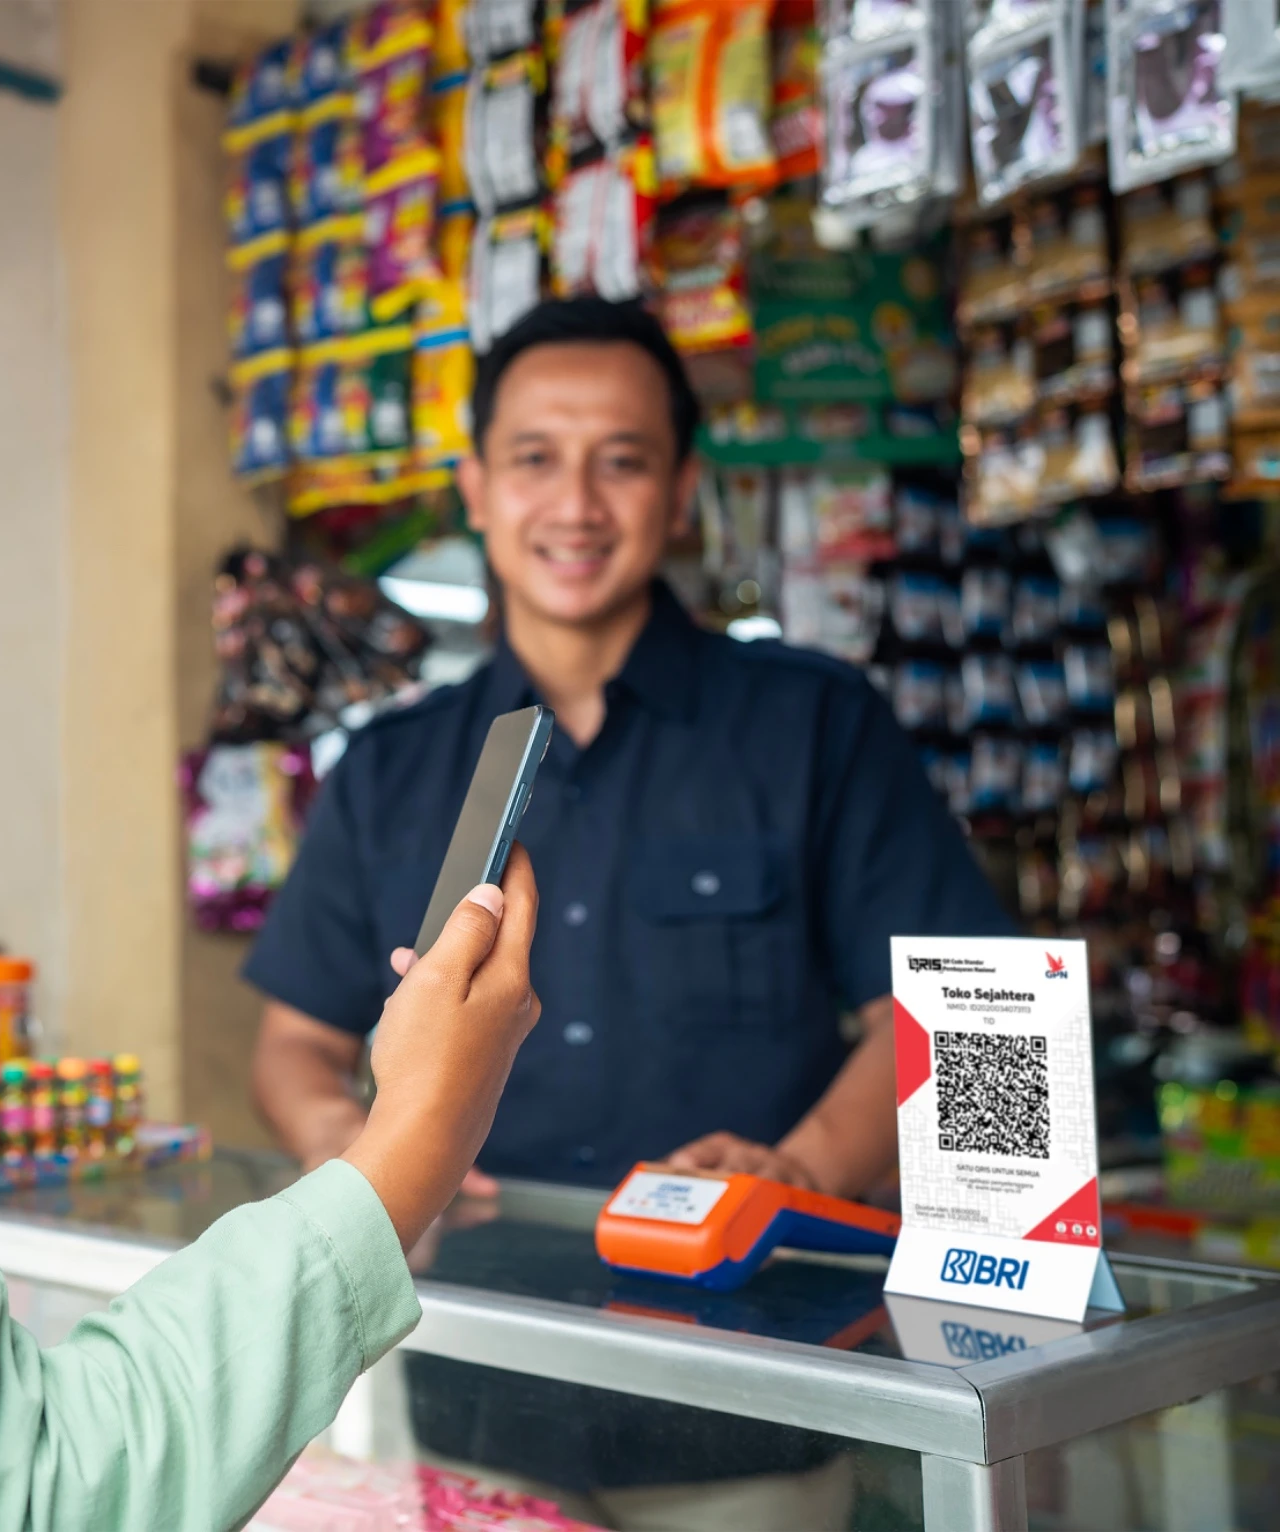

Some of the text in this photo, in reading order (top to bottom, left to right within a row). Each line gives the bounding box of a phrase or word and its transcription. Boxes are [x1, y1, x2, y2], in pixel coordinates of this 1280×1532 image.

[908, 958, 941, 972] QRIS
[942, 987, 1036, 1002] Toko Sejahtera
[974, 1254, 1030, 1290] BRI
